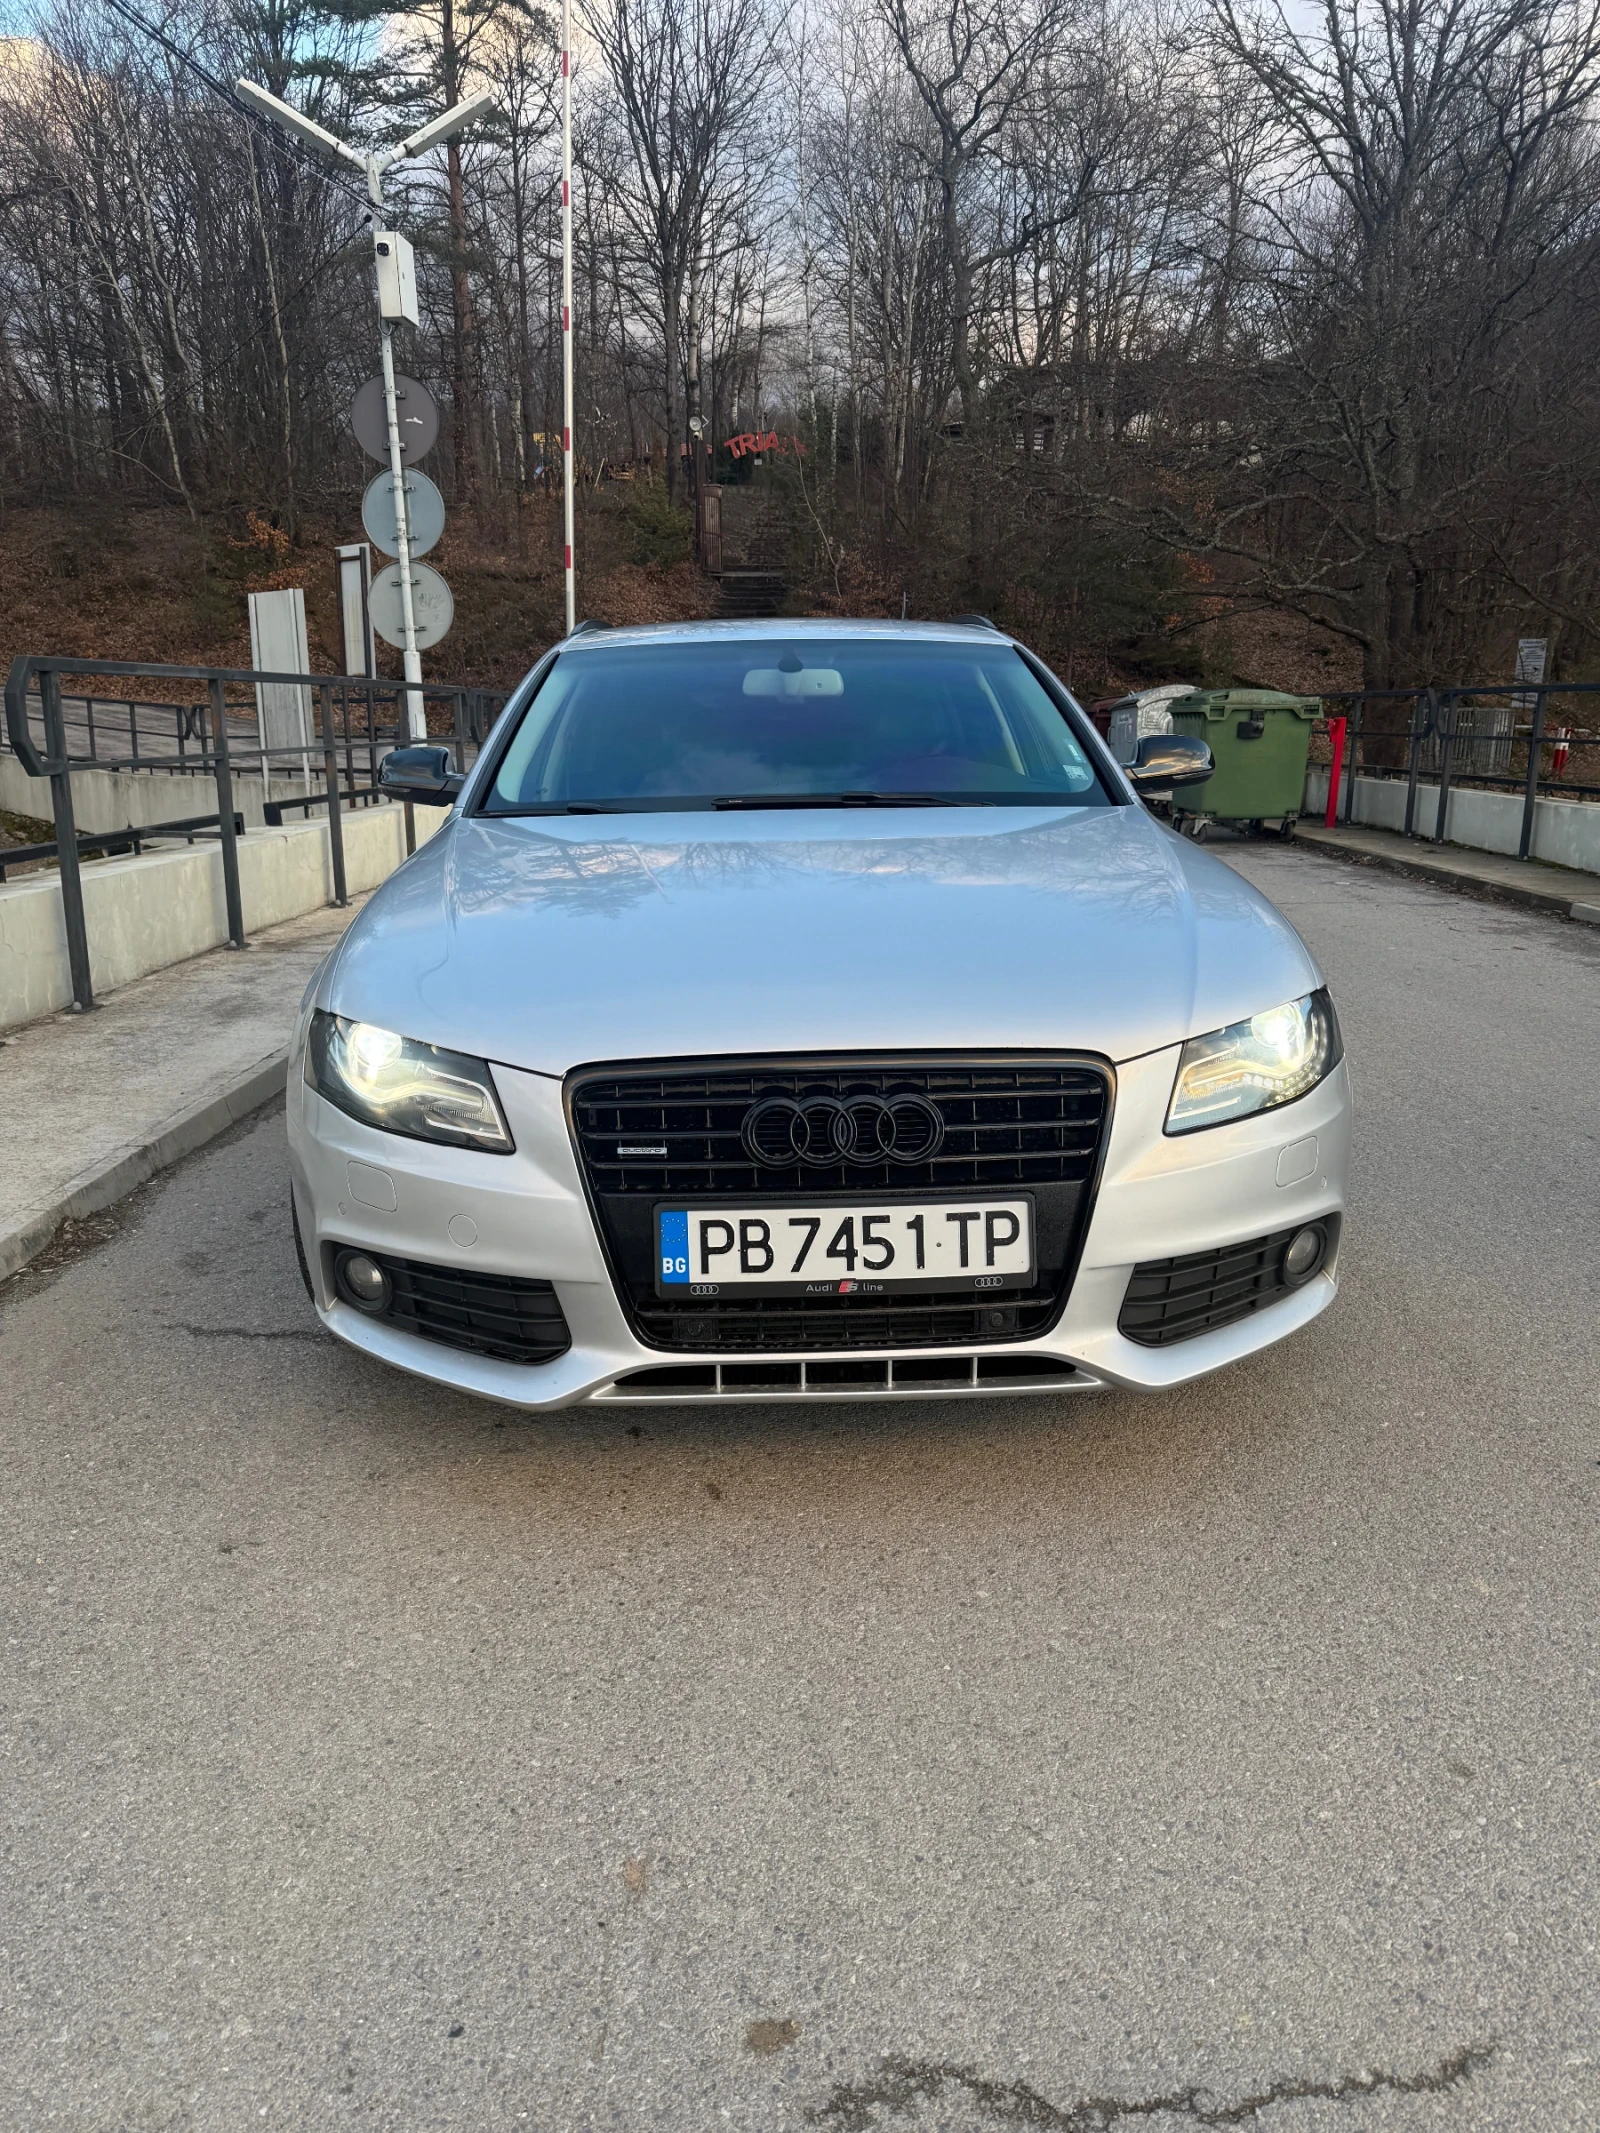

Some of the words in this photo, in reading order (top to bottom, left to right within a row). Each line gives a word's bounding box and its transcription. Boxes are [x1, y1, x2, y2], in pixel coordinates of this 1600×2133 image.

[699, 1218, 774, 1275] PB
[788, 1214, 925, 1273] 7451
[946, 1209, 1020, 1268] TP
[662, 1257, 686, 1274] BG
[805, 1283, 833, 1292] Audi
[863, 1282, 884, 1291] line
